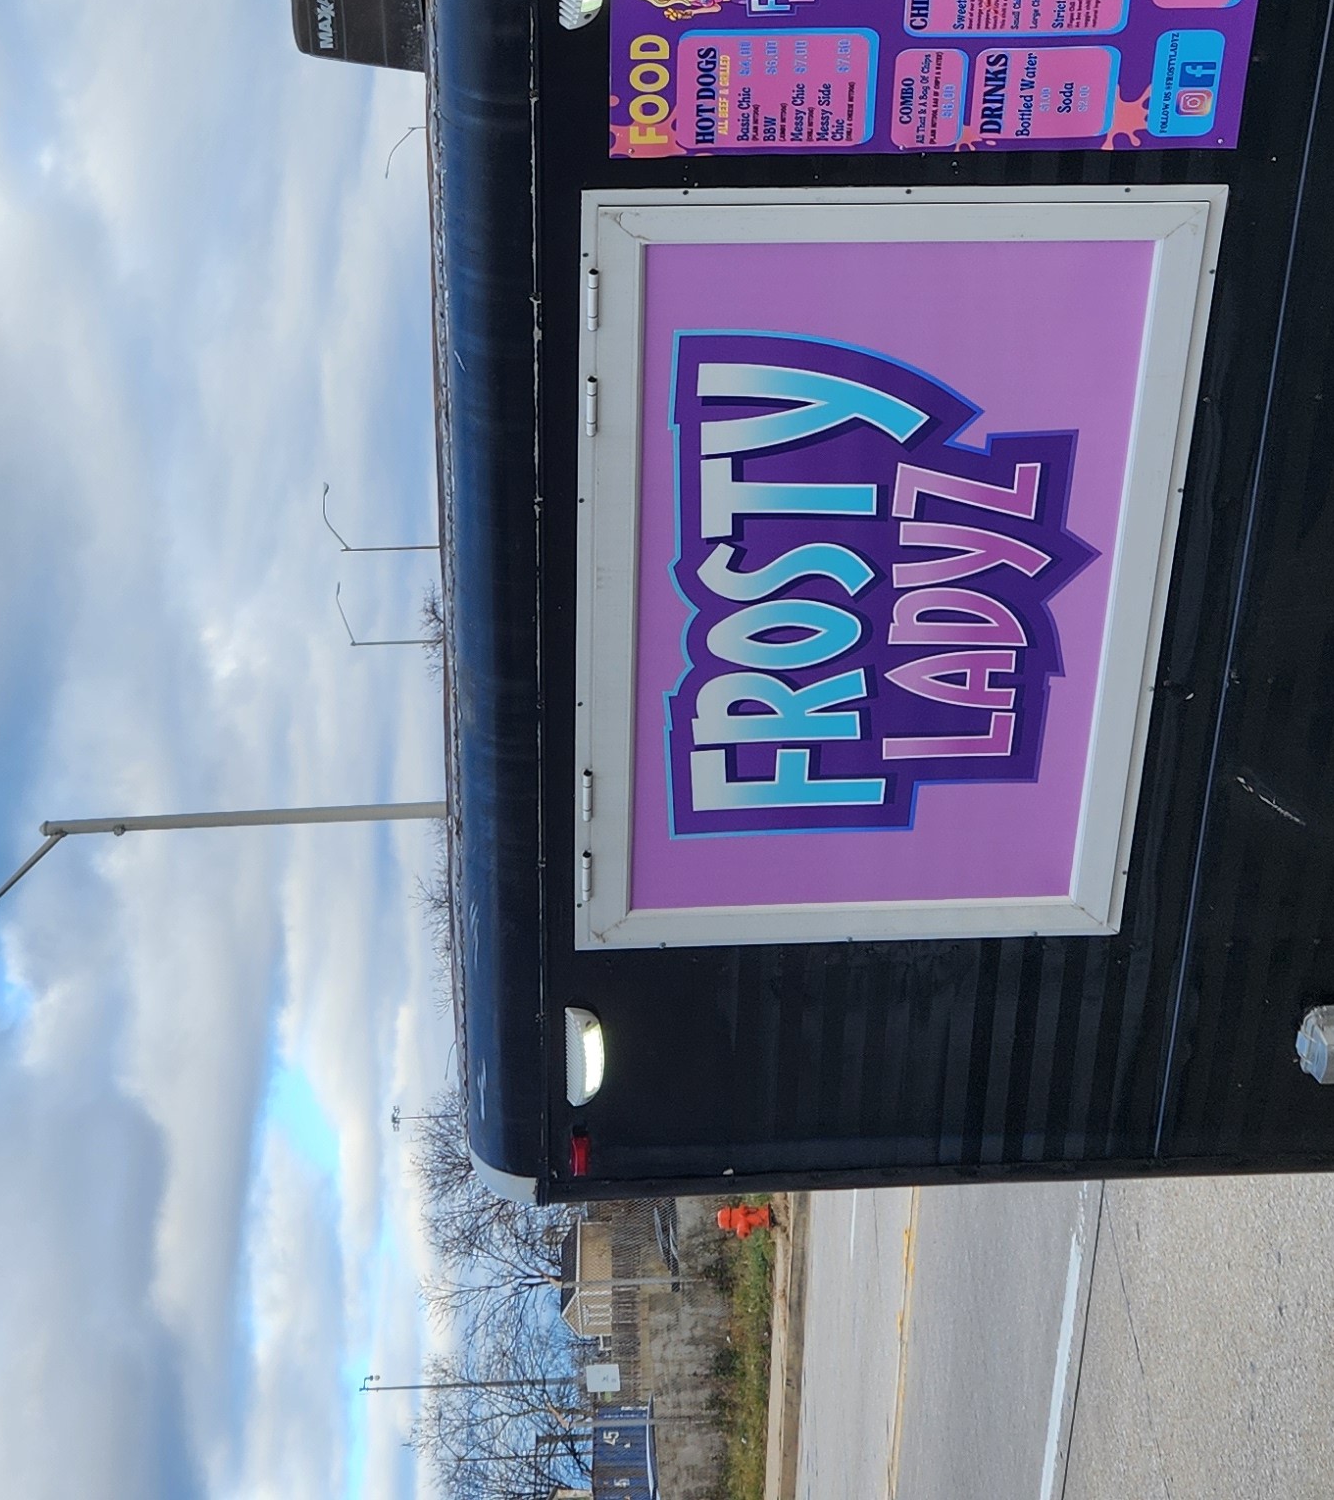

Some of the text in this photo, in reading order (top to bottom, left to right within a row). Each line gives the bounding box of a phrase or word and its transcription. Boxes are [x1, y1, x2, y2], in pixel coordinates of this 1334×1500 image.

[1011, 11, 1020, 29] Small
[1030, 9, 1041, 29] Large
[1051, 1, 1066, 28] Strict
[720, 55, 730, 86] GRILLED
[921, 54, 932, 74] Chips
[629, 34, 670, 145] FOOD
[919, 86, 930, 100] Bag
[920, 75, 929, 84] Of
[696, 47, 716, 144] HOT DOGS
[719, 97, 728, 118] BEEF
[899, 78, 914, 124] COMBO
[980, 54, 1008, 134] DRINKS
[1015, 53, 1037, 136] Bottled Water
[1057, 82, 1074, 113] Soda
[1163, 92, 1172, 101] US
[737, 87, 750, 141] Basic Chic
[790, 83, 806, 141] Messy Chic
[816, 83, 833, 141] Messy Side
[916, 117, 926, 133] That
[1159, 103, 1170, 133] FOLLOW
[718, 120, 728, 135] ALL
[763, 116, 776, 141] BBW
[831, 119, 844, 141] Chic
[916, 135, 924, 144] All
[689, 362, 929, 811] FROSTY
[881, 462, 1052, 761] LADYZ
